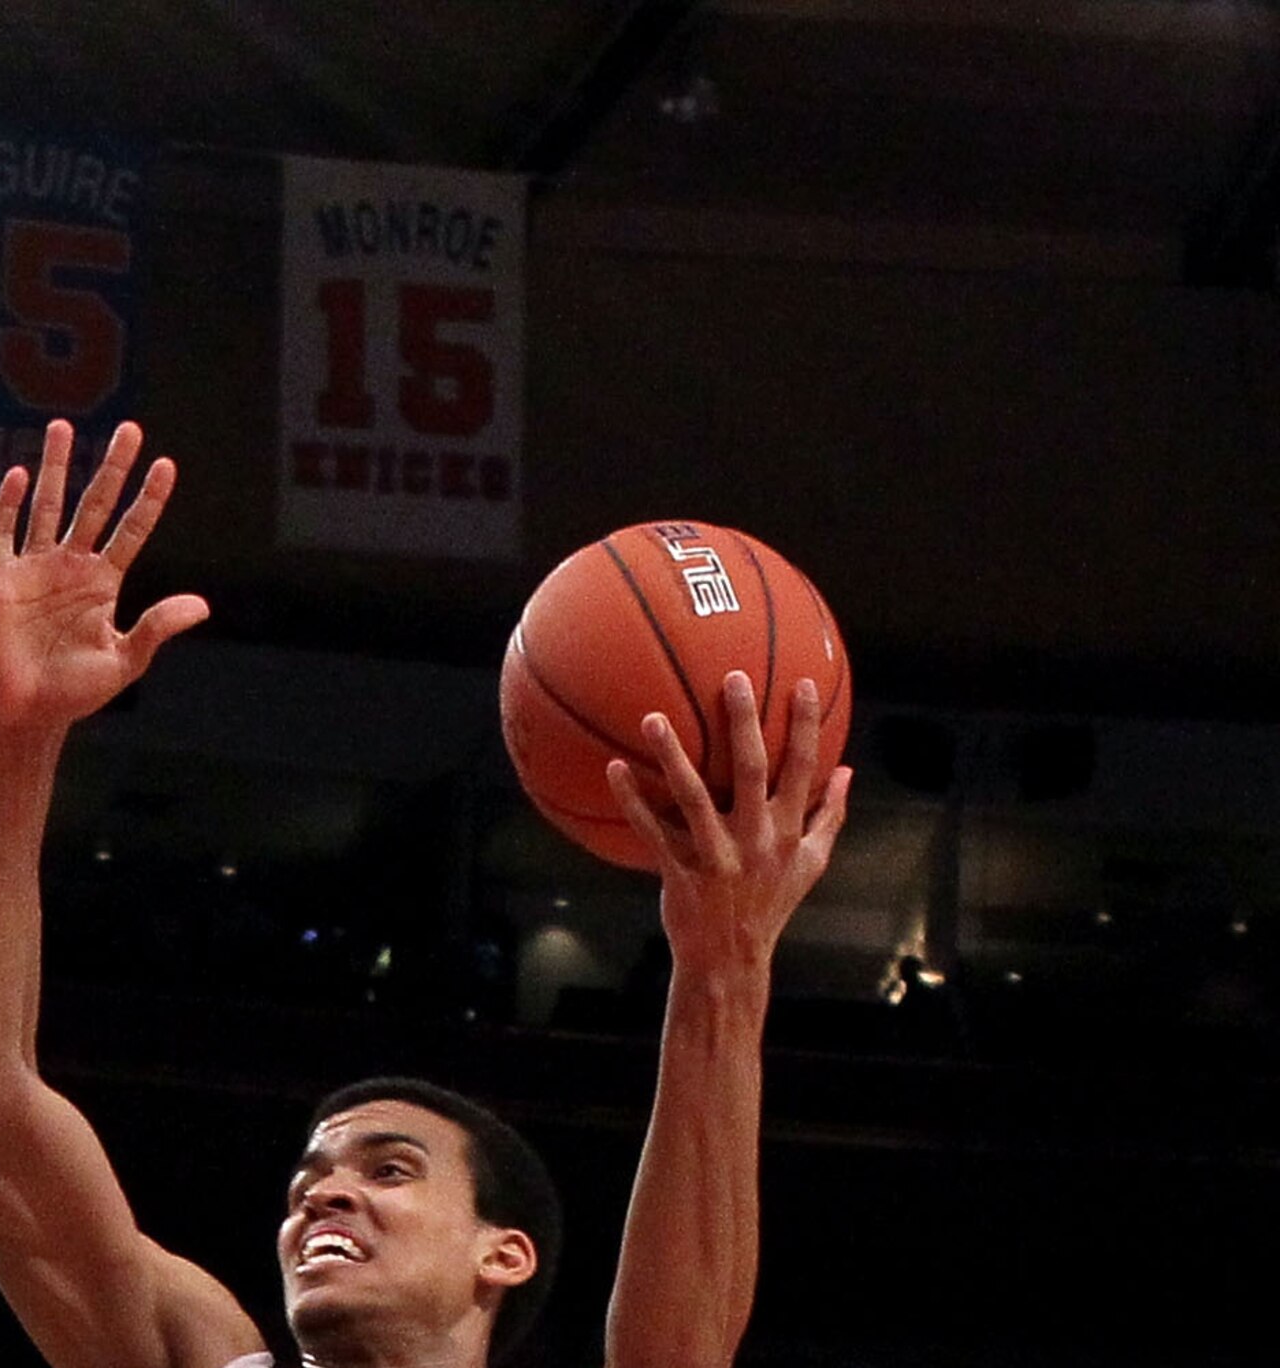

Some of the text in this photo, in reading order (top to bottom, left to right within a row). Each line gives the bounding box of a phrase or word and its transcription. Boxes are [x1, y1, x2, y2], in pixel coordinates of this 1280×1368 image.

[316, 200, 504, 269] MONROE
[317, 278, 496, 437] 15
[291, 441, 512, 501] KNICKS
